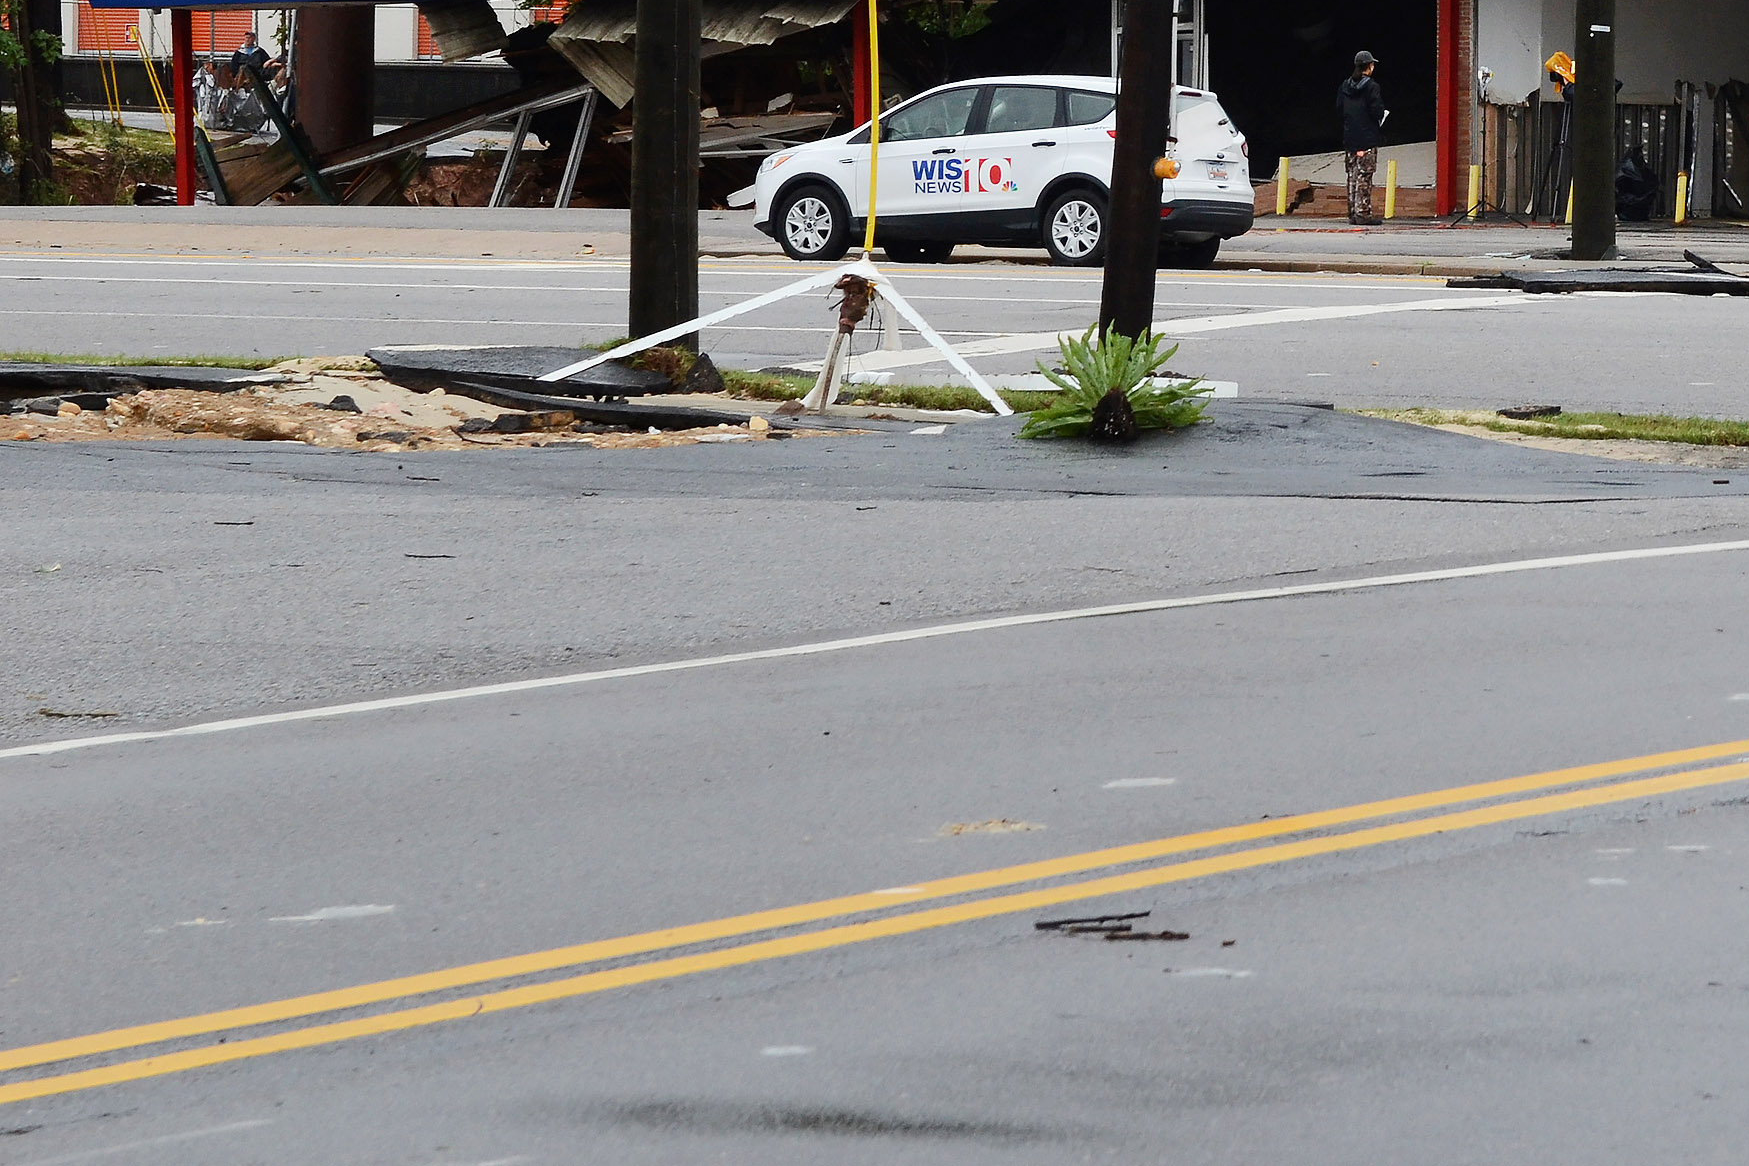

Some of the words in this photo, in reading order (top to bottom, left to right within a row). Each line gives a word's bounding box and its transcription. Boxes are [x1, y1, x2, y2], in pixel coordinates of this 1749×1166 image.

[912, 158, 963, 181] WIS
[963, 157, 1012, 192] 10
[914, 181, 962, 194] NEWS
